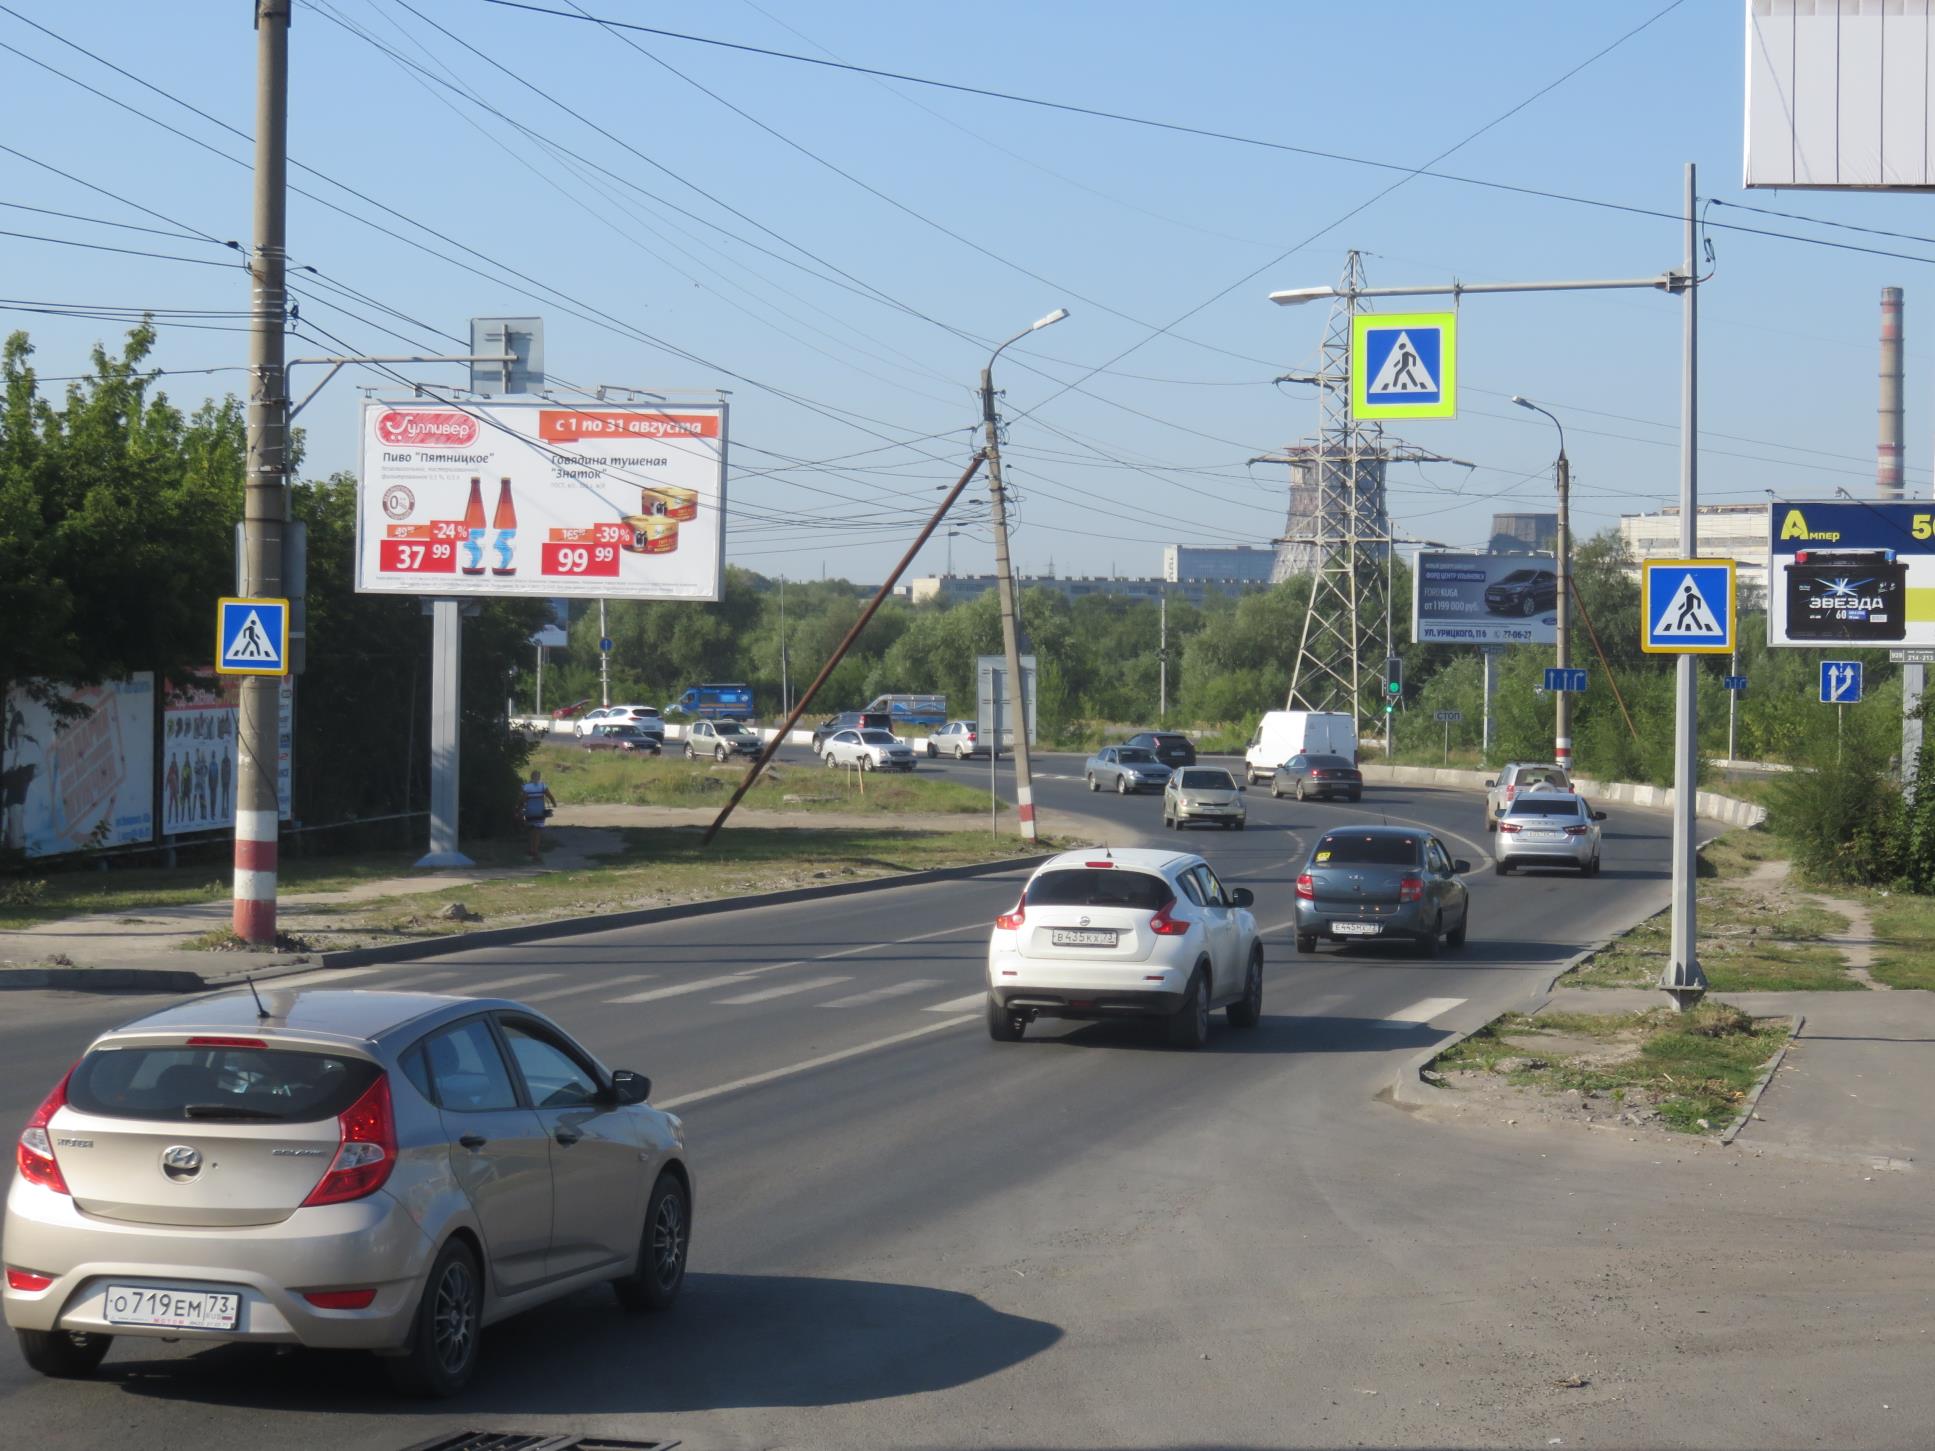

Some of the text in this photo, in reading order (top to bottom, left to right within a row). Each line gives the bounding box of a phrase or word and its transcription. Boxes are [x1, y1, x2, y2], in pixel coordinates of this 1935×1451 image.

[386, 415, 469, 439] Гулливер
[556, 419, 702, 436] с 1 по 31 августа
[383, 452, 412, 463] Пиво
[551, 455, 668, 468] Говядина тушеная
[1780, 509, 1841, 542] Ампер
[396, 544, 451, 569] 37 99
[558, 547, 614, 572] 99 99
[1809, 597, 1884, 610] ЗВЕЗДА
